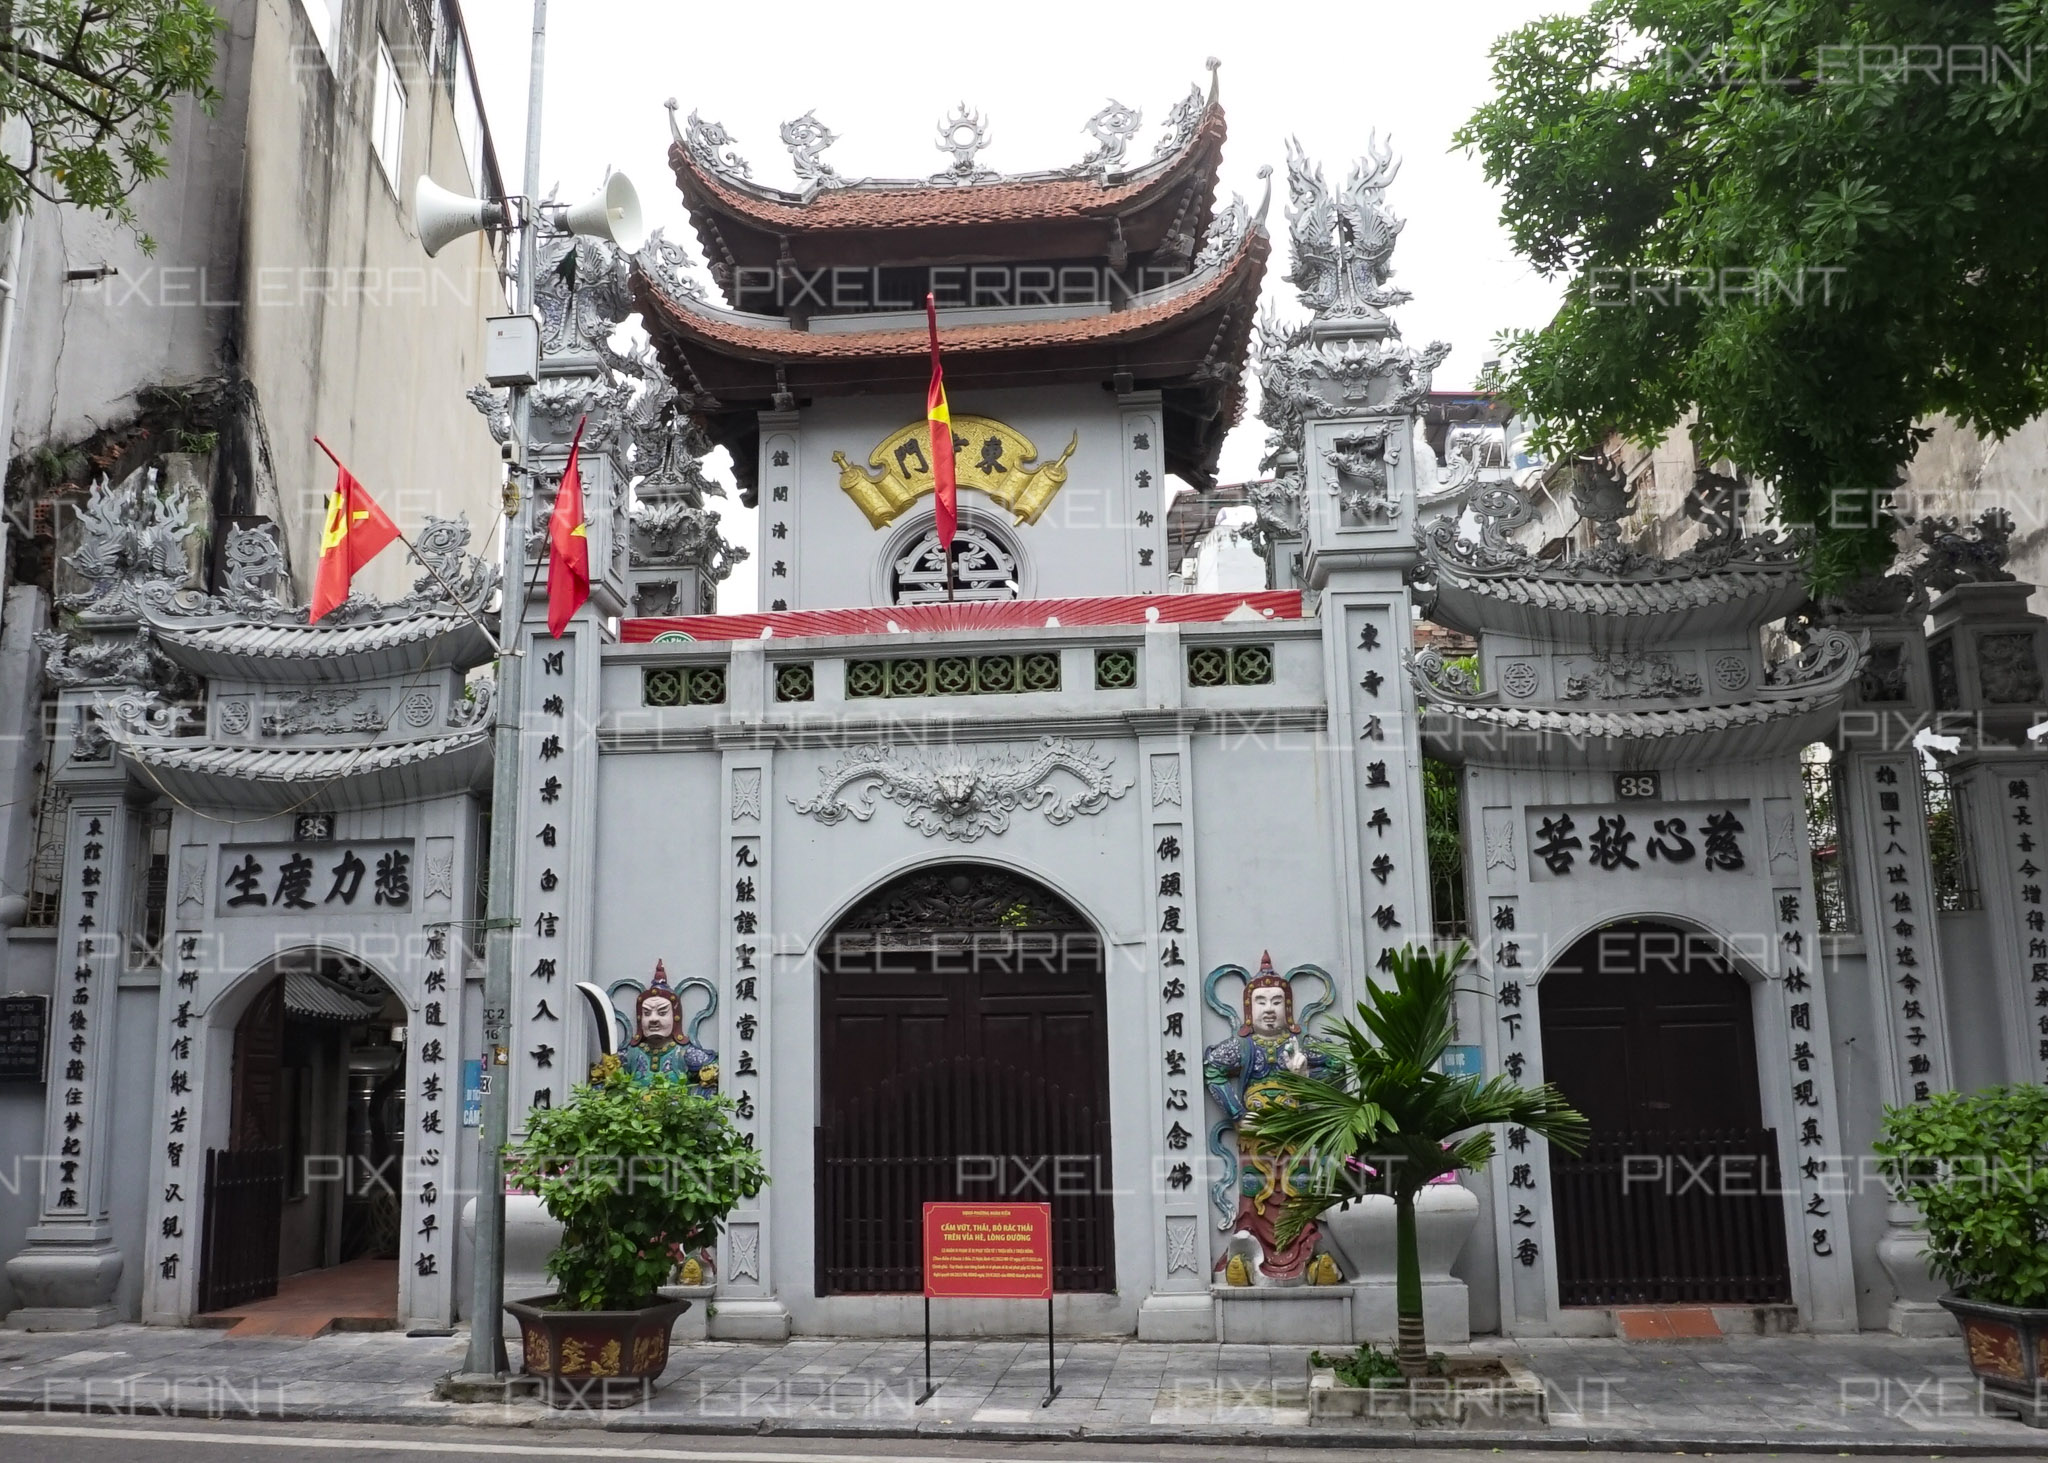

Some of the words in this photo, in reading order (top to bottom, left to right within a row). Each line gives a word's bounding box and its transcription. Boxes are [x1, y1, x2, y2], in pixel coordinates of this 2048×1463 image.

[1621, 777, 1654, 796] 38
[498, 1008, 505, 1020] 2
[485, 1029, 499, 1040] 16
[941, 1222, 956, 1231] CẤM
